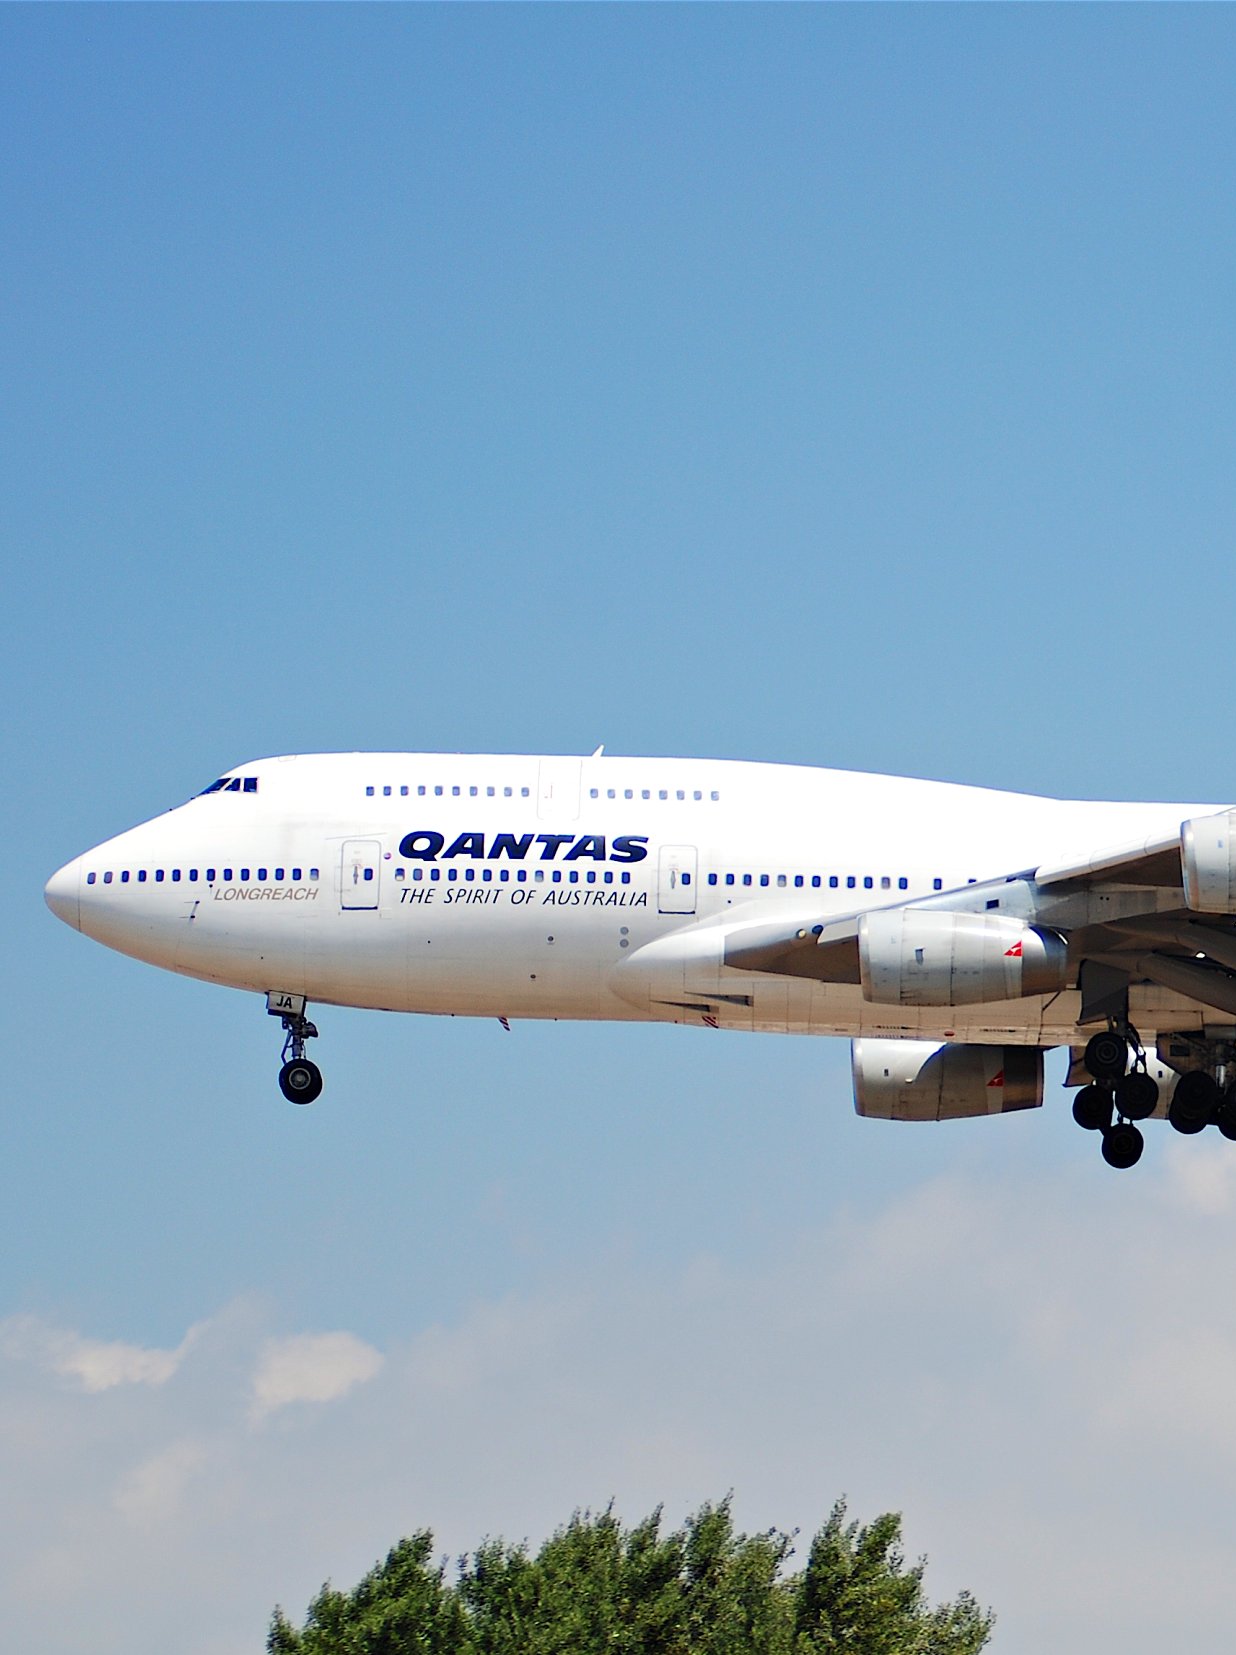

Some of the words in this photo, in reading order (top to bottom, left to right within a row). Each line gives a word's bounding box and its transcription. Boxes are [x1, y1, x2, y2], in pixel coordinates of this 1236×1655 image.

[399, 830, 649, 863] QANTAS
[214, 888, 319, 901] LONGREACH
[400, 888, 436, 904] THE
[443, 888, 504, 905] SPIRIT
[511, 889, 537, 905] OF
[543, 890, 648, 906] AUSTRALIA
[276, 995, 293, 1009] JA
